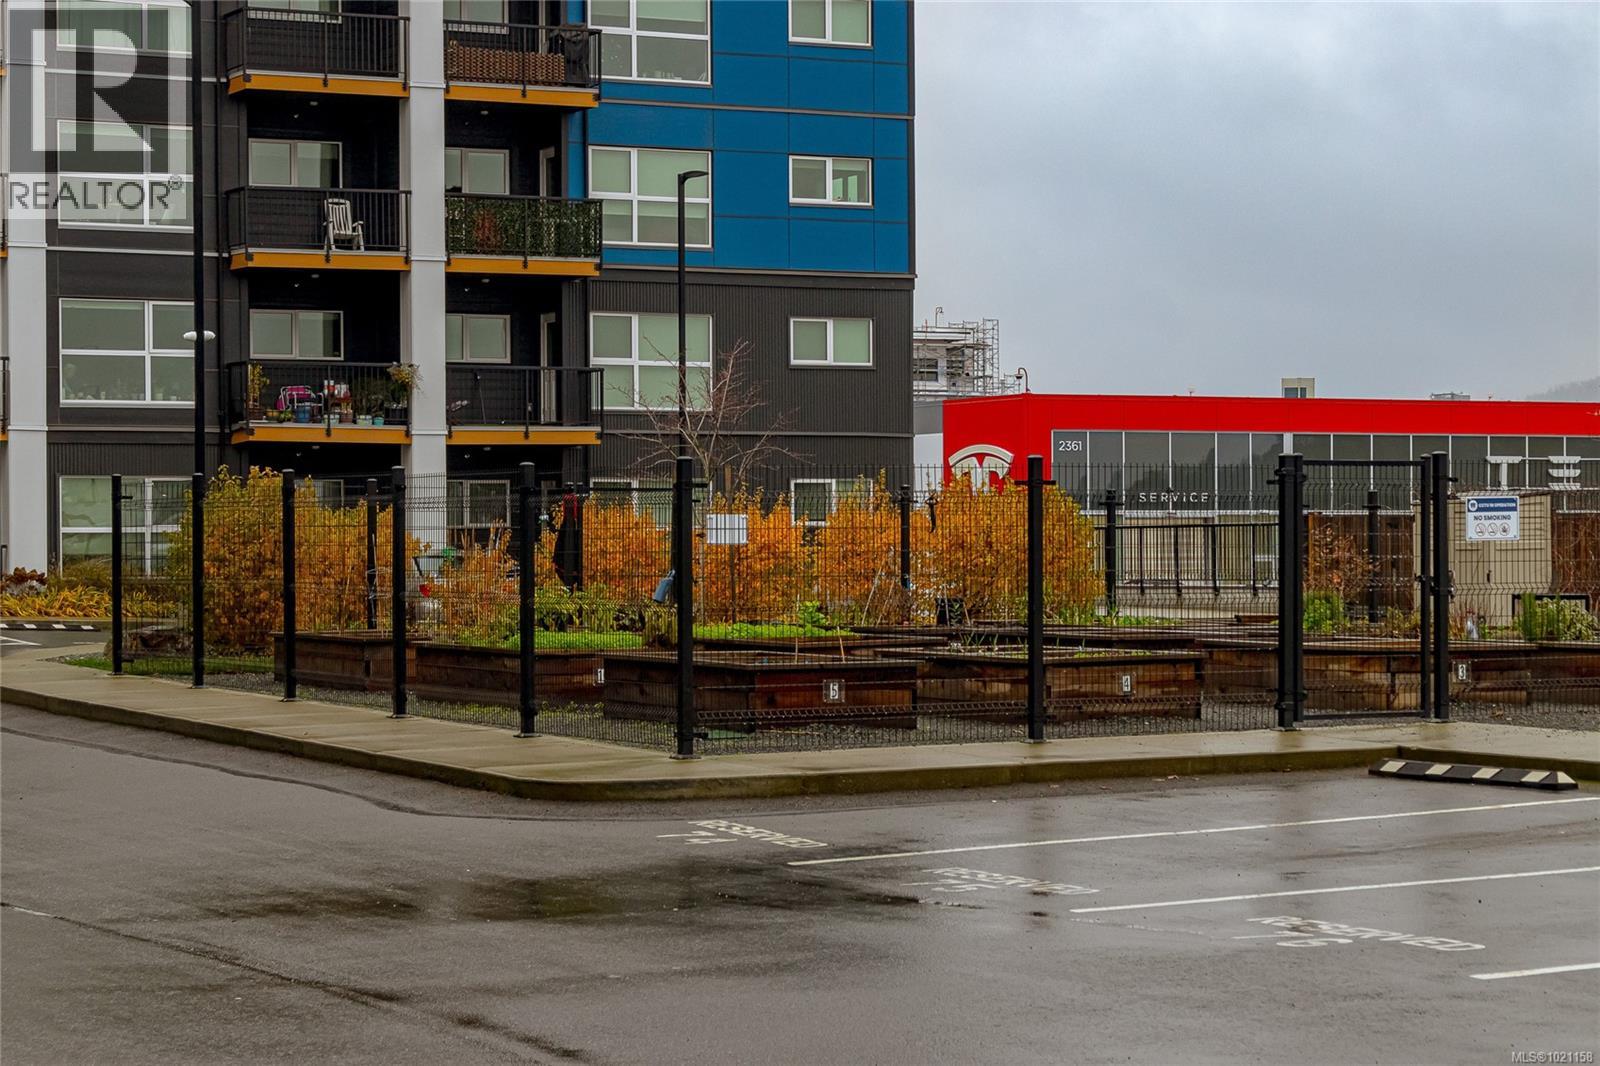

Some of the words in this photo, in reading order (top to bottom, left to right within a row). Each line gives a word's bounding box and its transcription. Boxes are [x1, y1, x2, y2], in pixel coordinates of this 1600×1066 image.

[1058, 440, 1082, 451] 2361
[1139, 492, 1208, 503] SERVICE
[687, 819, 828, 848] RESERVED
[921, 867, 1100, 896] RESERVED
[1246, 916, 1486, 951] RESERVED
